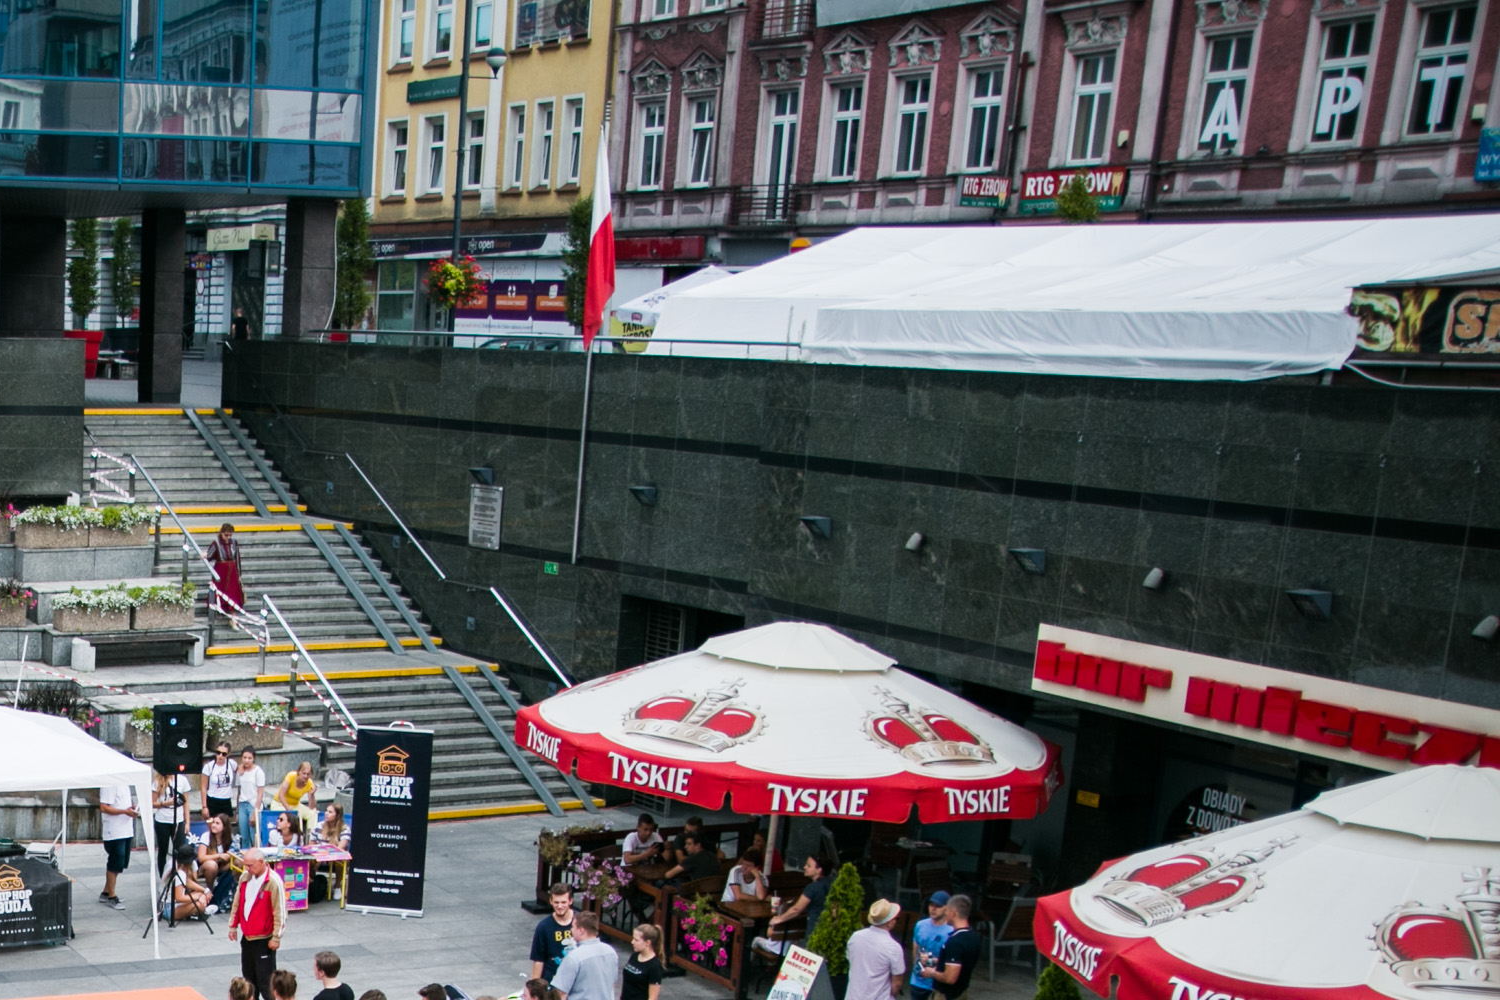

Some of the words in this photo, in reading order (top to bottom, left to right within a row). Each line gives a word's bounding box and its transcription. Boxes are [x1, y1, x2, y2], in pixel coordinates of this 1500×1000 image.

[963, 177, 979, 194] RTG
[1026, 176, 1054, 197] RTG
[381, 243, 396, 254] open
[478, 239, 494, 253] open
[526, 721, 561, 764] TYSKIE
[371, 774, 390, 785] HIP
[391, 776, 414, 787] HOP
[608, 752, 693, 797] TYSKIE
[370, 784, 412, 799] BUDA
[768, 783, 868, 817] TYSKIE
[944, 786, 1011, 815] TYSKIE
[1202, 787, 1247, 816] OBIADY
[1186, 806, 1196, 825] Z
[1196, 808, 1246, 832] DOWO
[12, 889, 33, 900] HOP
[1052, 920, 1103, 982] TYSKIE
